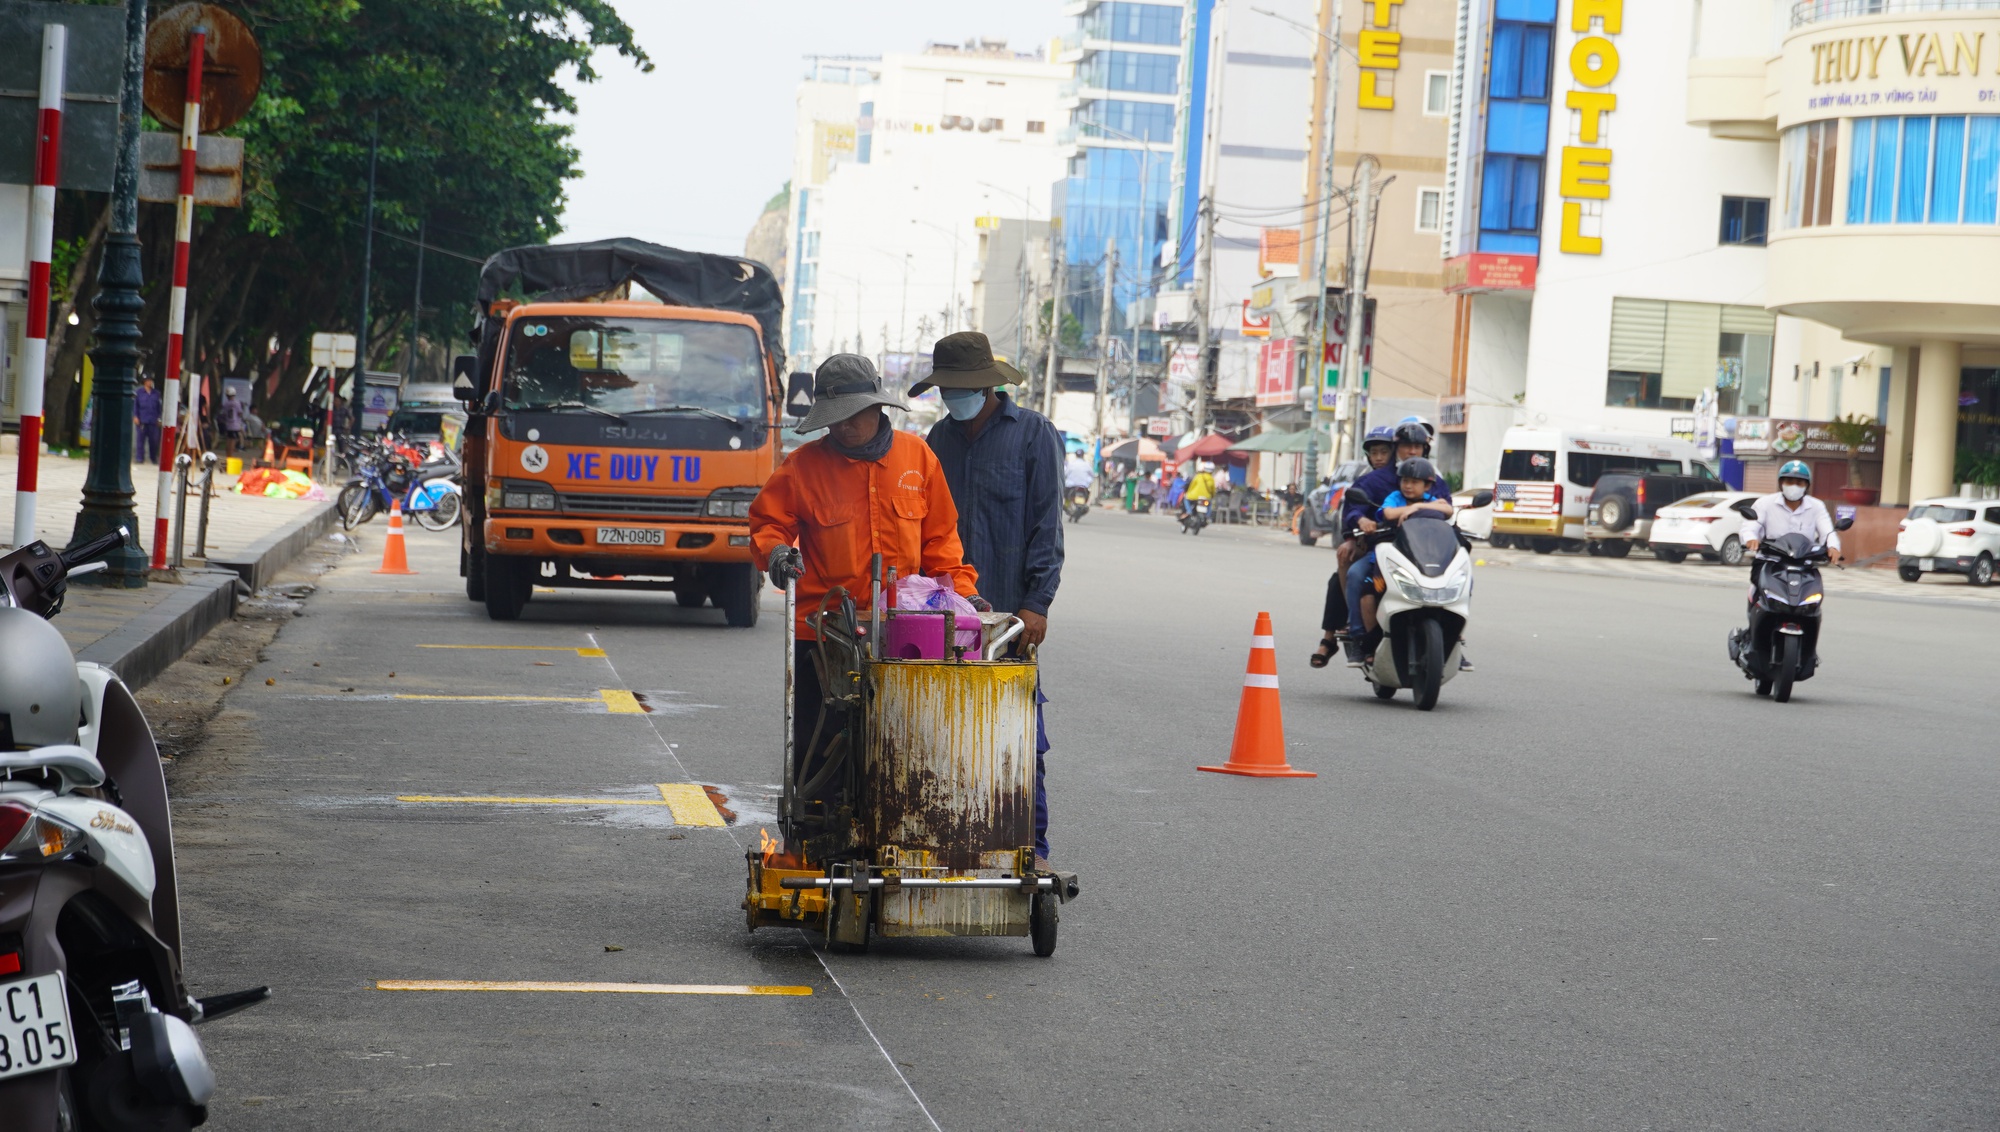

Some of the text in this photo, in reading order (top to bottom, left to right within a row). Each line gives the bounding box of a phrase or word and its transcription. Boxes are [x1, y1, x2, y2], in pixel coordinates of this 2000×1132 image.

[1811, 31, 1985, 86] THUY VAN
[1560, 0, 1624, 255] HOTEL
[566, 453, 701, 483] XE DUY TU
[601, 529, 661, 544] 72N-0905
